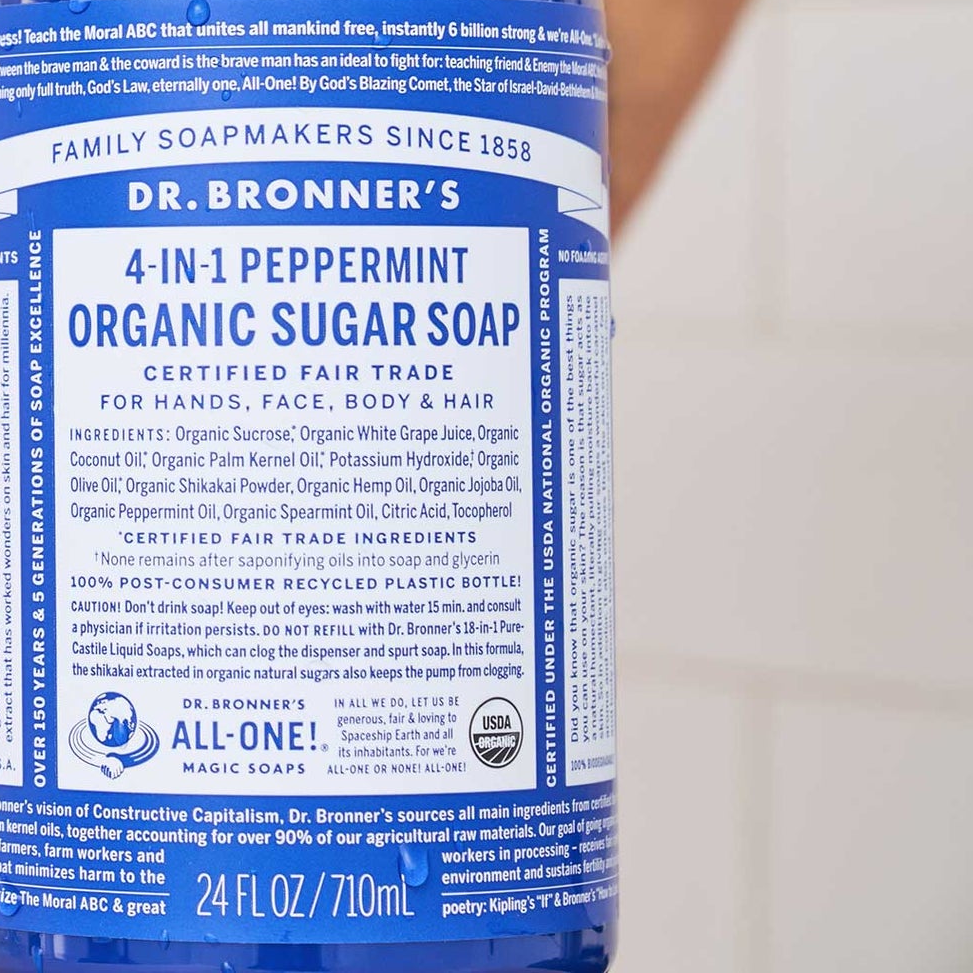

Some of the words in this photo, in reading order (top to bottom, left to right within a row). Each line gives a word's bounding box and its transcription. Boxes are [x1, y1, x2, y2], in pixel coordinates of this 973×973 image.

[24, 28, 57, 43] Teach
[60, 27, 81, 41] the
[85, 24, 123, 40] Moral
[126, 23, 156, 38] ABC
[161, 23, 192, 37] that
[197, 22, 245, 36] unites
[249, 21, 268, 35] all
[273, 20, 340, 35] mankind
[344, 20, 378, 38] free,
[383, 21, 445, 39] instantly
[449, 22, 457, 36] 6
[461, 23, 499, 38] billion
[502, 25, 536, 43] strong
[538, 26, 545, 41] &
[547, 28, 569, 43] we're
[53, 131, 145, 163] FAMILY
[159, 124, 372, 149] SOAPMAKERS
[387, 126, 470, 152] SINCE
[481, 135, 530, 162] 1858
[129, 182, 197, 210] DR.
[209, 179, 459, 209] BRONNER'S
[126, 248, 226, 284] 4-IN-1
[242, 247, 468, 283] PEPPERMINT
[539, 229, 550, 320] PROGRAM
[29, 230, 42, 353] EXCELLENCE
[0, 293, 10, 363] millennia.
[69, 303, 255, 347] ORGANIC
[272, 302, 416, 346] SUGAR
[428, 302, 519, 346] SOAP
[1, 369, 9, 387] for
[144, 365, 286, 381] CERTIFIED
[301, 365, 358, 380] FAIR
[372, 365, 452, 380] TRADE
[541, 328, 551, 413] ORGANIC
[31, 360, 42, 410] SOAP
[1, 394, 9, 418] hair
[101, 395, 142, 409] FOR
[155, 394, 249, 411] HANDS,
[263, 394, 333, 411] FACE,
[346, 394, 409, 409] BODY
[421, 394, 433, 409] &
[445, 394, 493, 409] HAIR
[2, 423, 10, 449] and
[31, 417, 42, 441] OF
[70, 429, 169, 441] INGREDIENTS:
[176, 426, 229, 445] Organic
[300, 426, 354, 445] Organic
[358, 426, 396, 440] White
[400, 425, 437, 444] Grape
[441, 425, 475, 441] Juice,
[478, 425, 518, 444] Organic
[2, 454, 10, 482] skin
[542, 420, 552, 513] NATIONAL
[4, 487, 10, 504] on
[71, 477, 98, 492] Olive
[126, 477, 175, 497] Organic
[179, 478, 236, 493] Shikakai
[241, 478, 293, 494] Powder,
[297, 477, 349, 497] Organic
[354, 478, 392, 496] Hemp
[396, 477, 416, 494] Oil,
[419, 477, 465, 496] Organic
[468, 477, 503, 496] Jojoba
[506, 476, 521, 492] Oil,
[31, 448, 44, 585] GENERATIONS
[71, 503, 115, 522] Organic
[119, 503, 194, 522] Peppermint
[198, 504, 220, 521] Oil,
[224, 504, 276, 523] Organic
[281, 504, 352, 523] Spearmint
[356, 503, 377, 520] Oil,
[382, 503, 417, 518] Citric
[420, 503, 450, 519] Acid,
[452, 502, 511, 521] Tocopherol
[3, 508, 11, 569] wonders
[232, 533, 273, 544] FAIR
[283, 533, 345, 544] TRADE
[356, 532, 476, 544] INGREDIENTS
[543, 521, 553, 570] USDA
[139, 553, 194, 566] remains
[199, 553, 234, 567] after
[239, 553, 324, 570] saponifying
[329, 553, 353, 567] oils
[358, 553, 385, 567] into
[389, 556, 421, 569] soap
[425, 552, 448, 566] and
[452, 551, 499, 569] glycerin
[71, 576, 112, 588] 100%
[120, 577, 274, 589] POST-CONSUMER
[284, 578, 377, 589] RECYCLED
[386, 577, 455, 589] PLASTIC
[462, 576, 520, 588] BOTTLE!
[544, 577, 555, 613] THE
[3, 573, 11, 625] worked
[33, 592, 44, 602] 5
[71, 601, 120, 612] CAUTION!
[125, 600, 154, 613] Don't
[158, 601, 187, 613] drink
[191, 601, 223, 617] soap!
[227, 601, 256, 617] Keep
[260, 602, 279, 614] out
[283, 602, 295, 614] of
[299, 605, 329, 617] eyes:
[333, 601, 362, 614] wash
[366, 601, 390, 613] with
[394, 601, 425, 613] water
[428, 601, 439, 613] 15
[442, 600, 464, 612] min.
[467, 600, 485, 612] and
[487, 599, 521, 612] consult
[33, 608, 44, 621] &
[33, 628, 45, 690] YEARS
[545, 620, 555, 683] UNDER
[4, 659, 12, 687] that
[4, 692, 12, 742] extract
[34, 697, 45, 730] 150
[183, 699, 207, 709] DR.
[213, 699, 304, 710] BRONNER'S
[337, 716, 386, 727] generous,
[389, 713, 405, 723] fair
[418, 713, 445, 725] loving
[448, 712, 456, 722] to
[483, 715, 511, 730] USDA
[172, 721, 316, 750] ALL-ONE!
[342, 730, 392, 743] Spaceship
[396, 729, 420, 740] Earth
[424, 729, 439, 739] and
[478, 735, 516, 749] ORGANIC
[546, 690, 556, 787] CERTIFIED
[34, 737, 45, 787] OVER
[183, 763, 239, 773] MAGIC
[249, 763, 304, 774] SOAPS
[36, 802, 71, 816] vision
[76, 804, 89, 817] of
[93, 804, 187, 822] Constructive
[193, 807, 284, 825] Capitalism,
[289, 809, 311, 823] Dr.
[317, 808, 393, 823] Bronner's
[398, 810, 454, 822] sources
[459, 806, 474, 820] all
[480, 805, 509, 819] main
[513, 801, 570, 820] ingredients
[572, 799, 589, 812] from
[197, 873, 228, 915] 24
[237, 874, 265, 917] FL
